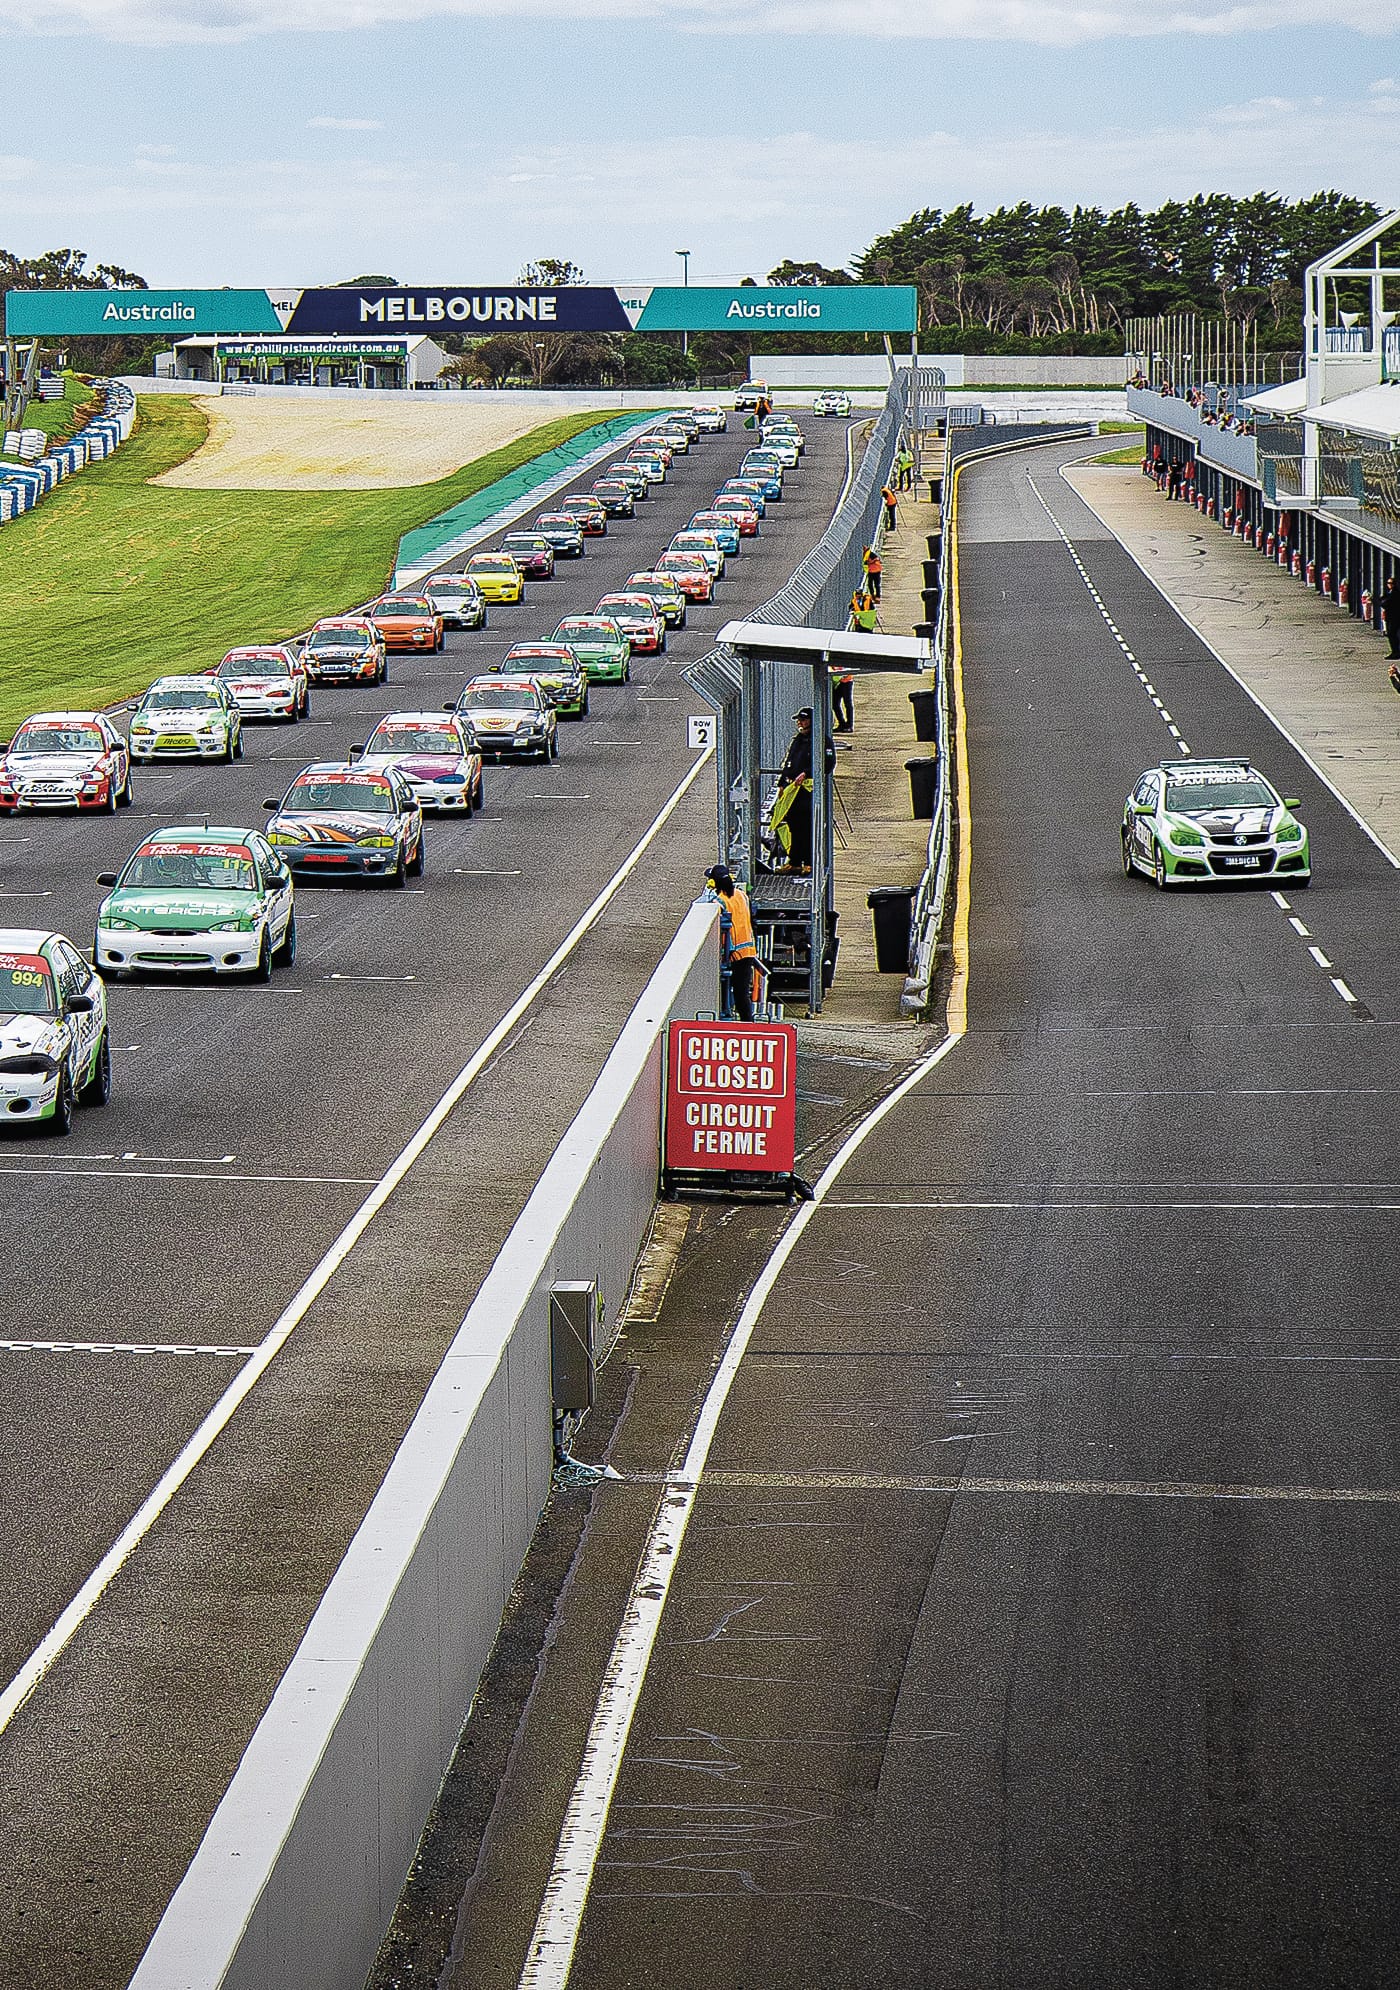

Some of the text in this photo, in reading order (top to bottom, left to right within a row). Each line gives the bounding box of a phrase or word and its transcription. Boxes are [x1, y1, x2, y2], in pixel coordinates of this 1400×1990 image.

[103, 301, 196, 320] Australia
[271, 302, 296, 311] MEL
[360, 297, 557, 321] MELBOURNE
[621, 300, 646, 309] MEL
[726, 300, 821, 318] Australia
[225, 343, 400, 355] www.phillipislandcircuit.com.au
[697, 728, 708, 744] 2
[1167, 775, 1262, 787] TEAM MEDICAL
[373, 786, 391, 796] 84
[222, 859, 253, 872] 117
[11, 971, 43, 988] 994
[687, 1036, 778, 1063] CIRCUIT
[688, 1063, 774, 1090] CLOSED
[686, 1102, 777, 1129] CIRCUIT
[693, 1130, 767, 1156] FERME
